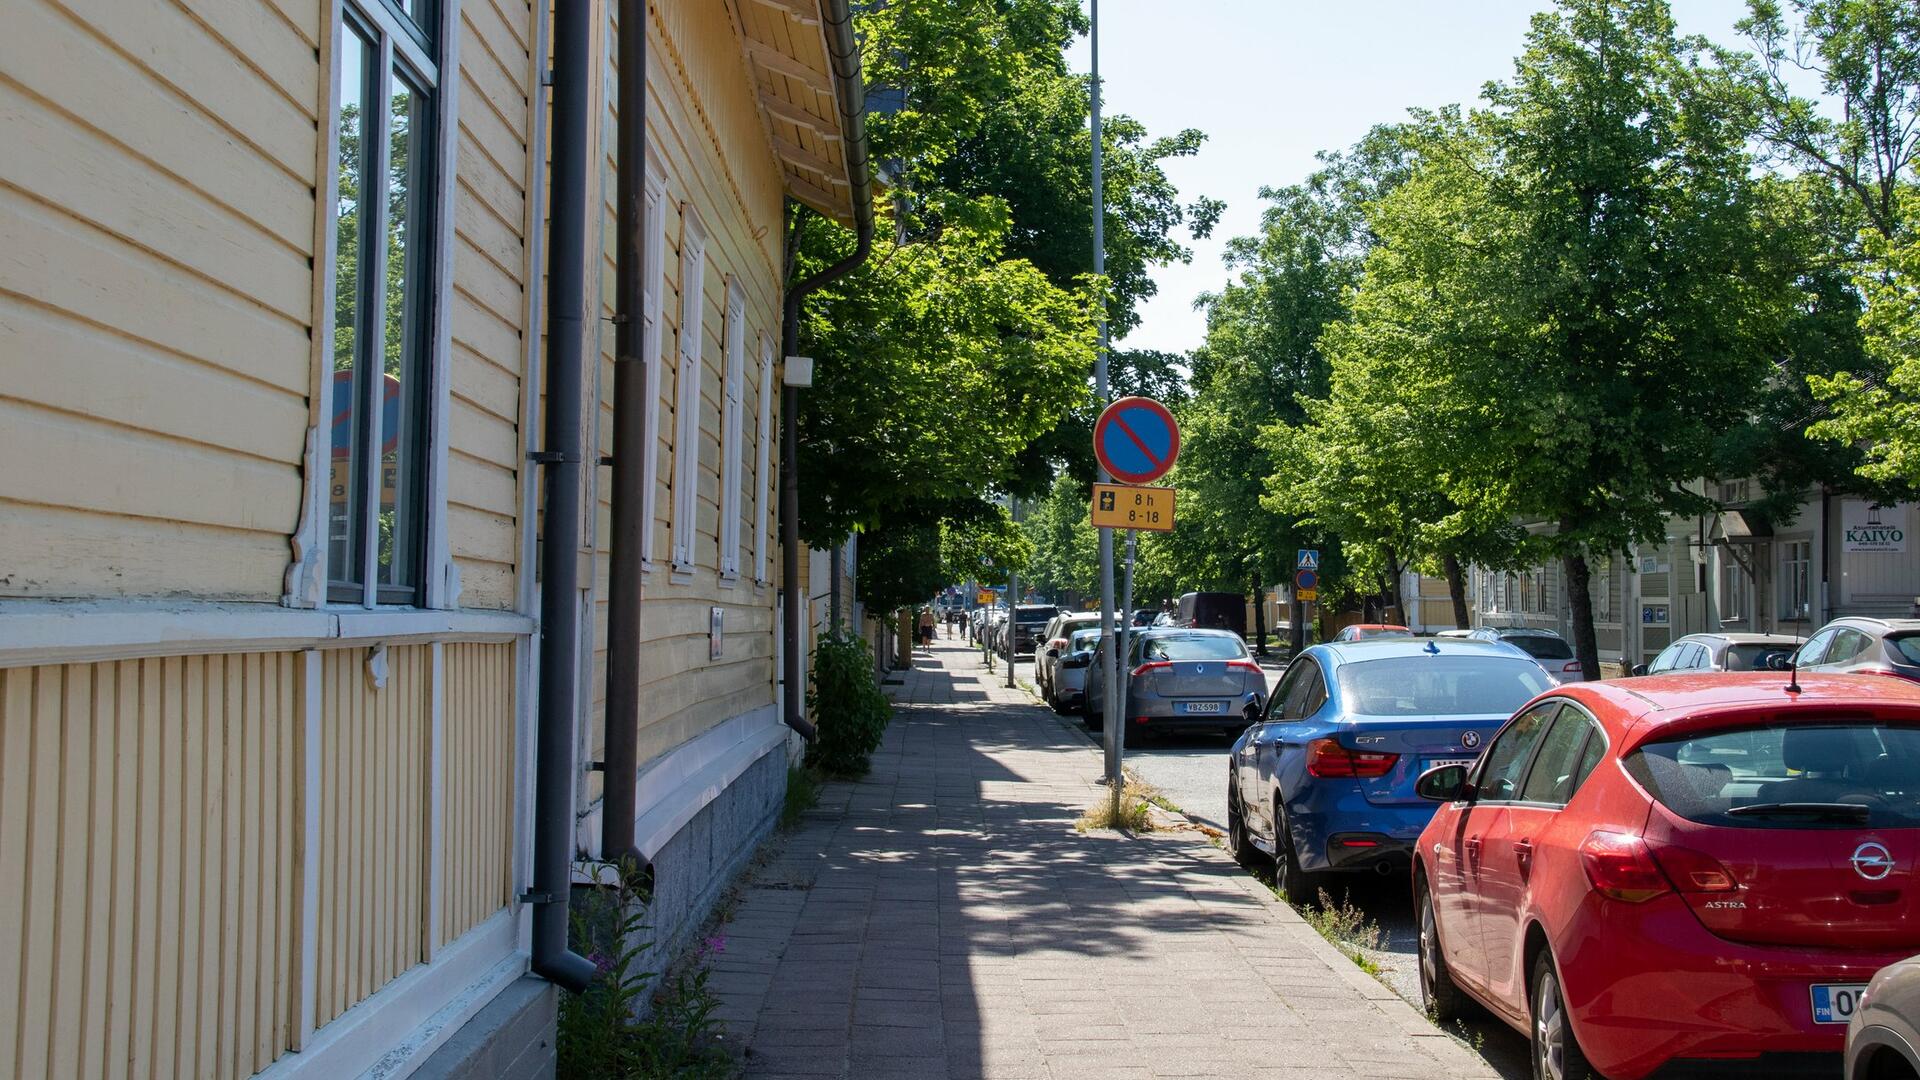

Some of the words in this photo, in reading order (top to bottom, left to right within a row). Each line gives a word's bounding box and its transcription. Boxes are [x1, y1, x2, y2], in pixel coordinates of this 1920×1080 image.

[1135, 493, 1142, 506] 8
[1146, 494, 1154, 506] h
[1128, 510, 1159, 523] 8-18
[1845, 530, 1903, 542] KAIVO
[1188, 703, 1219, 711] VBZ-598
[1355, 736, 1385, 744] GT
[1704, 901, 1747, 909] ASTRA
[1816, 1007, 1831, 1016] FIN
